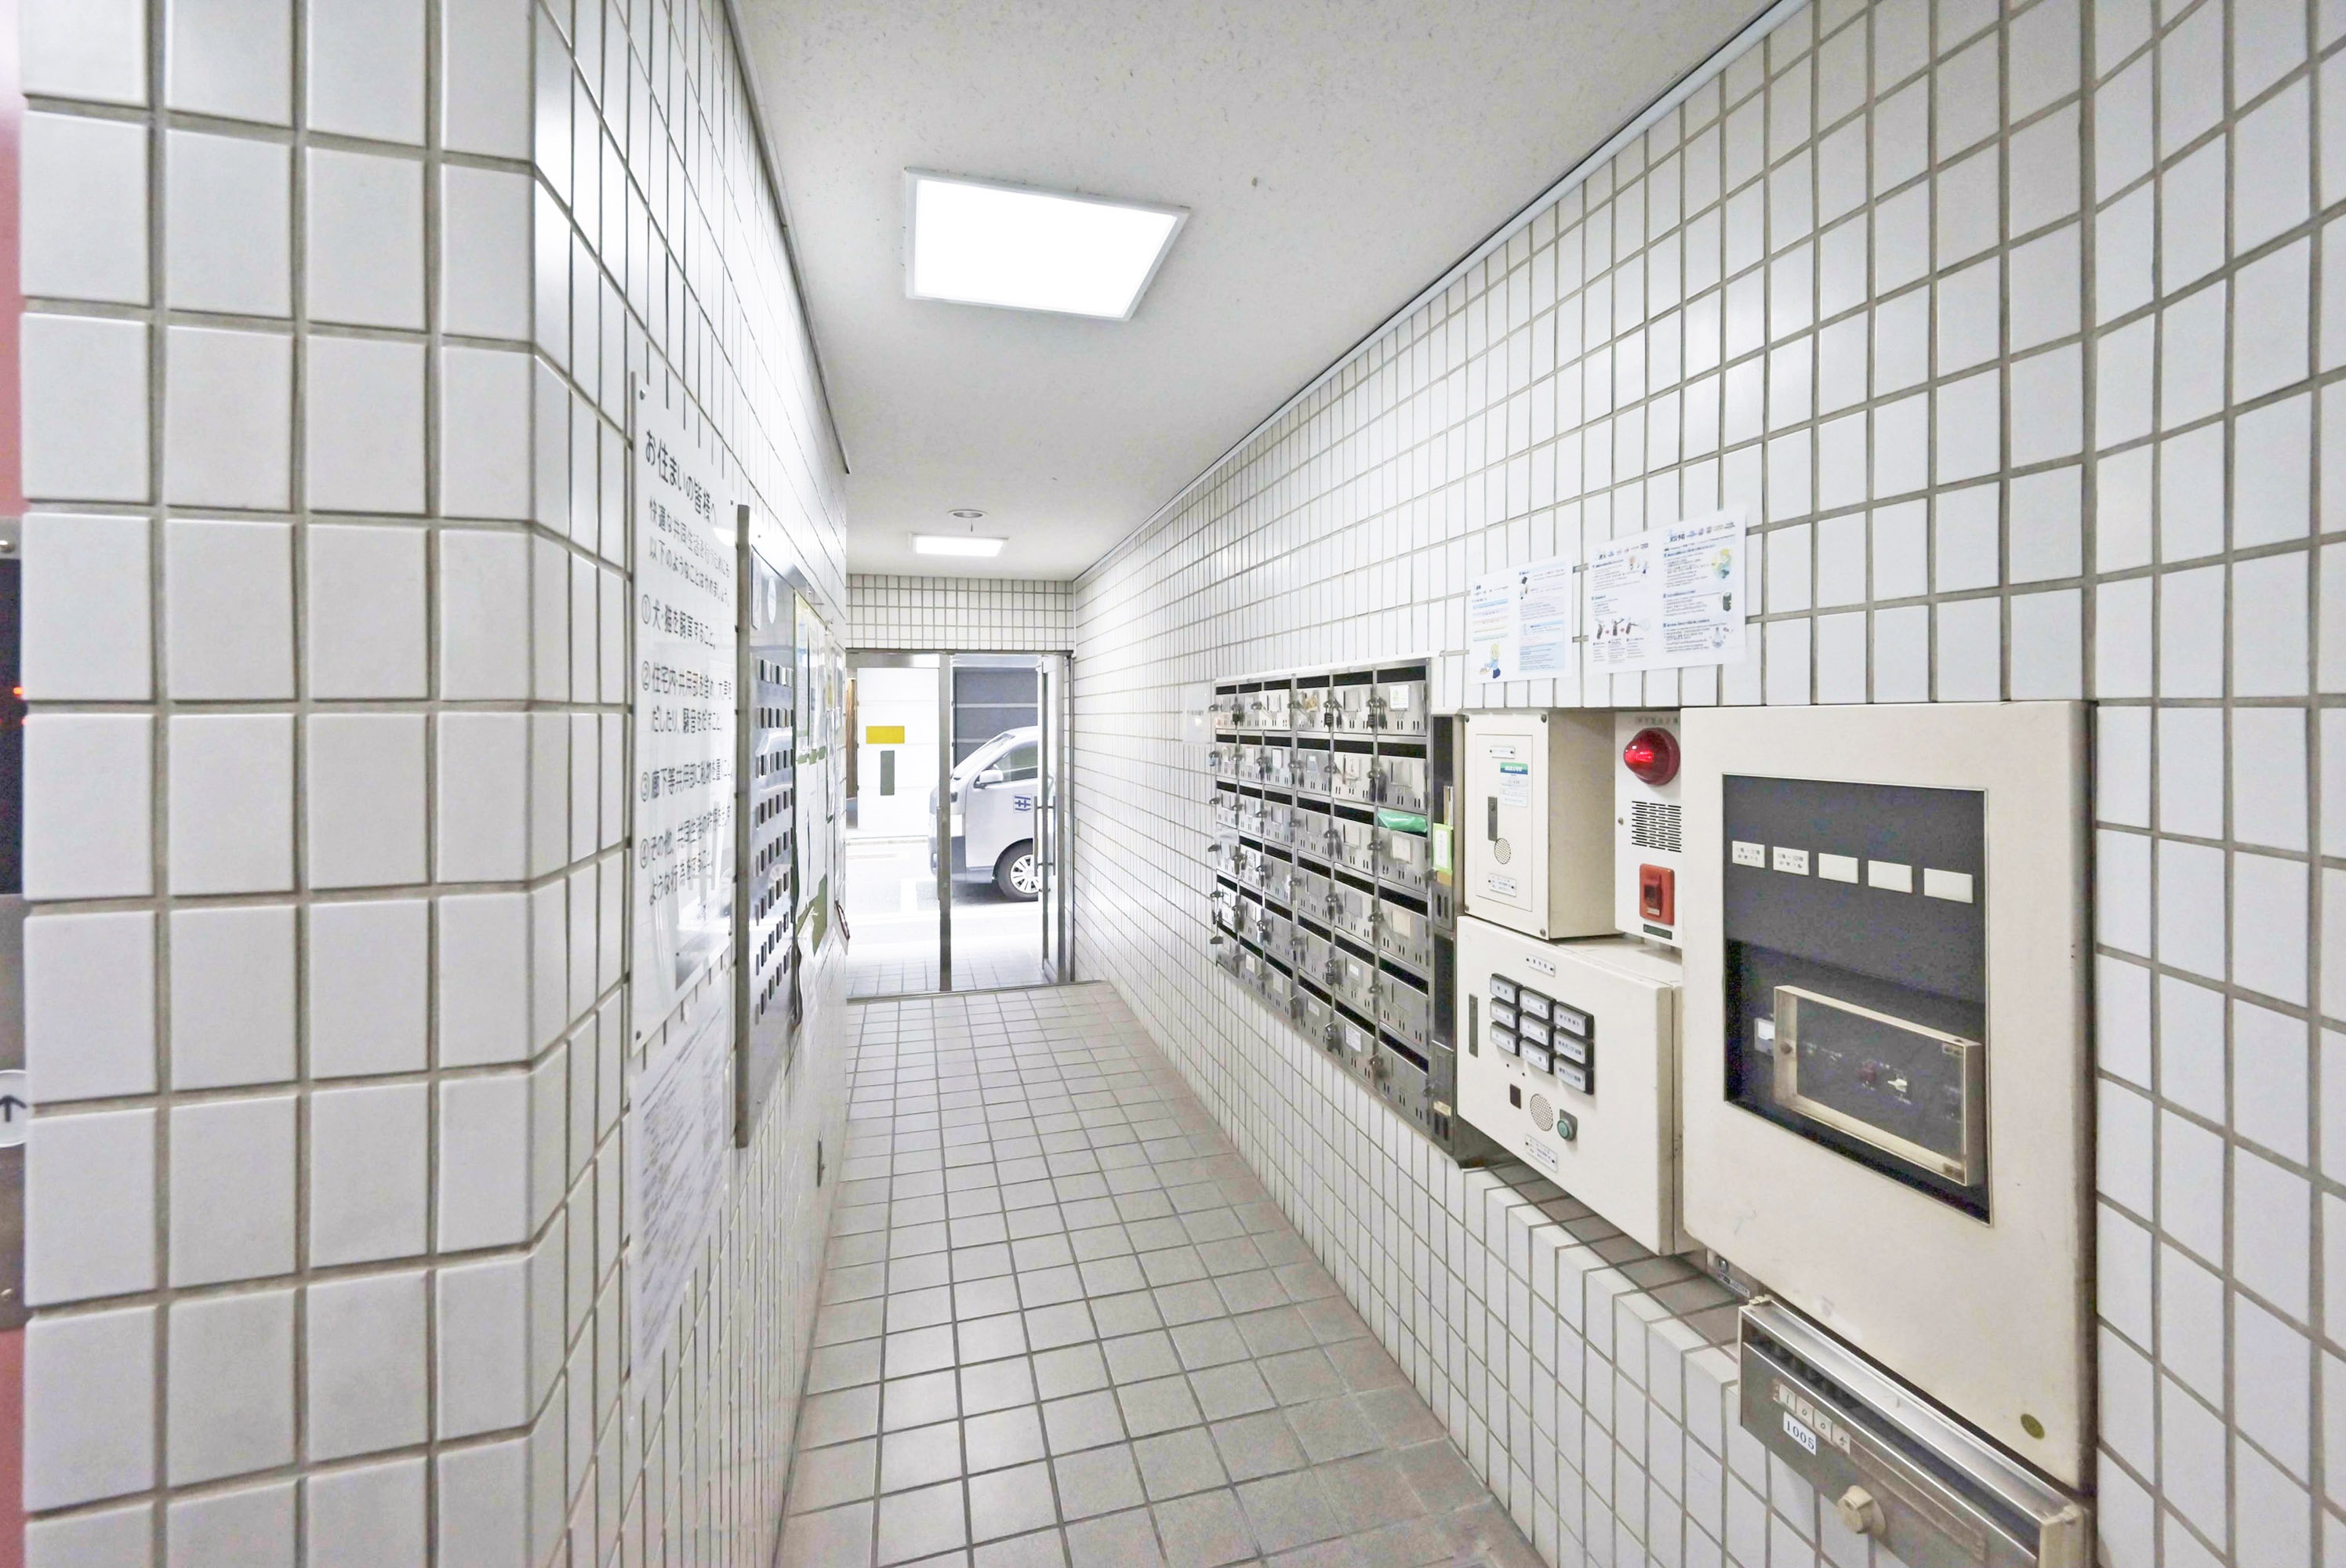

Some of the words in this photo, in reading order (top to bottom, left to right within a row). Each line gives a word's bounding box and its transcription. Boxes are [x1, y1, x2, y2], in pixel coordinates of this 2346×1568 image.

[645, 429, 717, 525] お住まいの皆様へ
[1787, 1421, 1814, 1450] 1005
